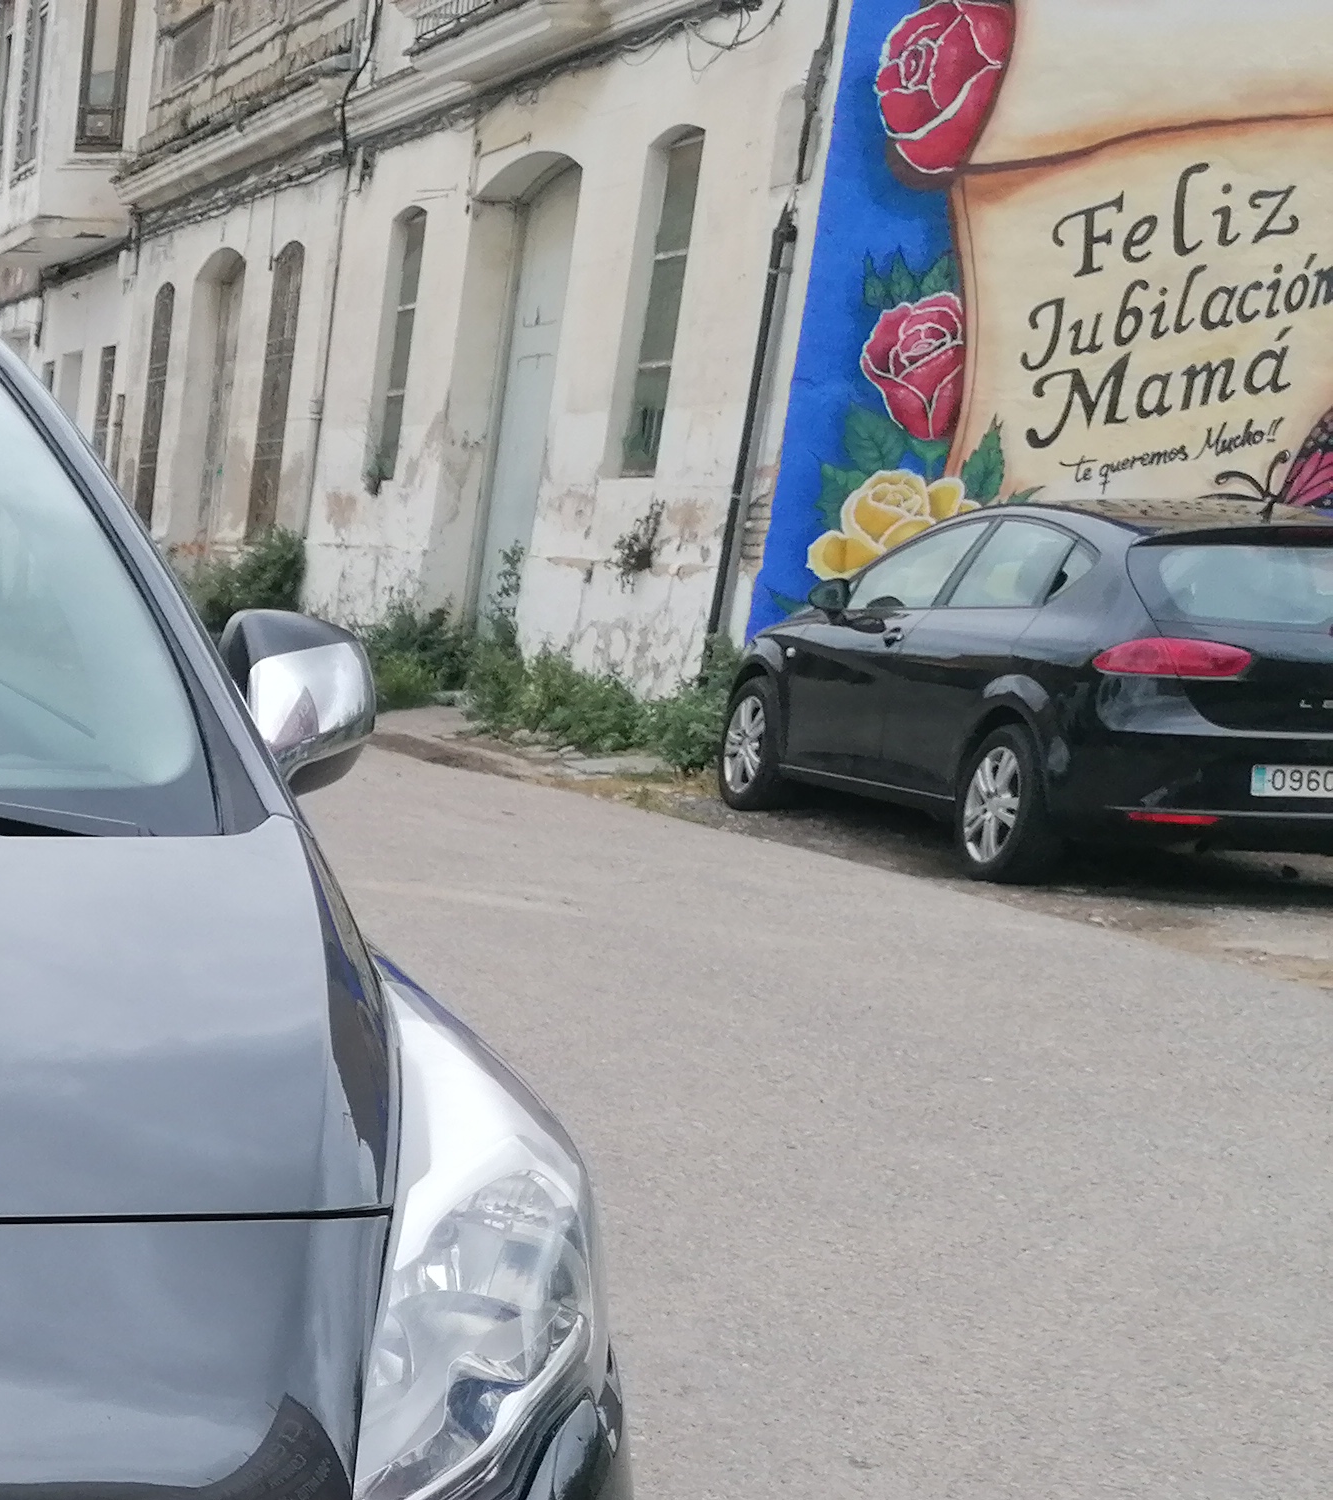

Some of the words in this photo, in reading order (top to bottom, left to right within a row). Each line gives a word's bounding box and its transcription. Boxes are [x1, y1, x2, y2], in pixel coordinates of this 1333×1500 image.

[1052, 162, 1300, 278] Feliz
[1020, 253, 1333, 371] Jubilación
[1025, 326, 1293, 449] Mamá
[1098, 444, 1189, 495] queremos
